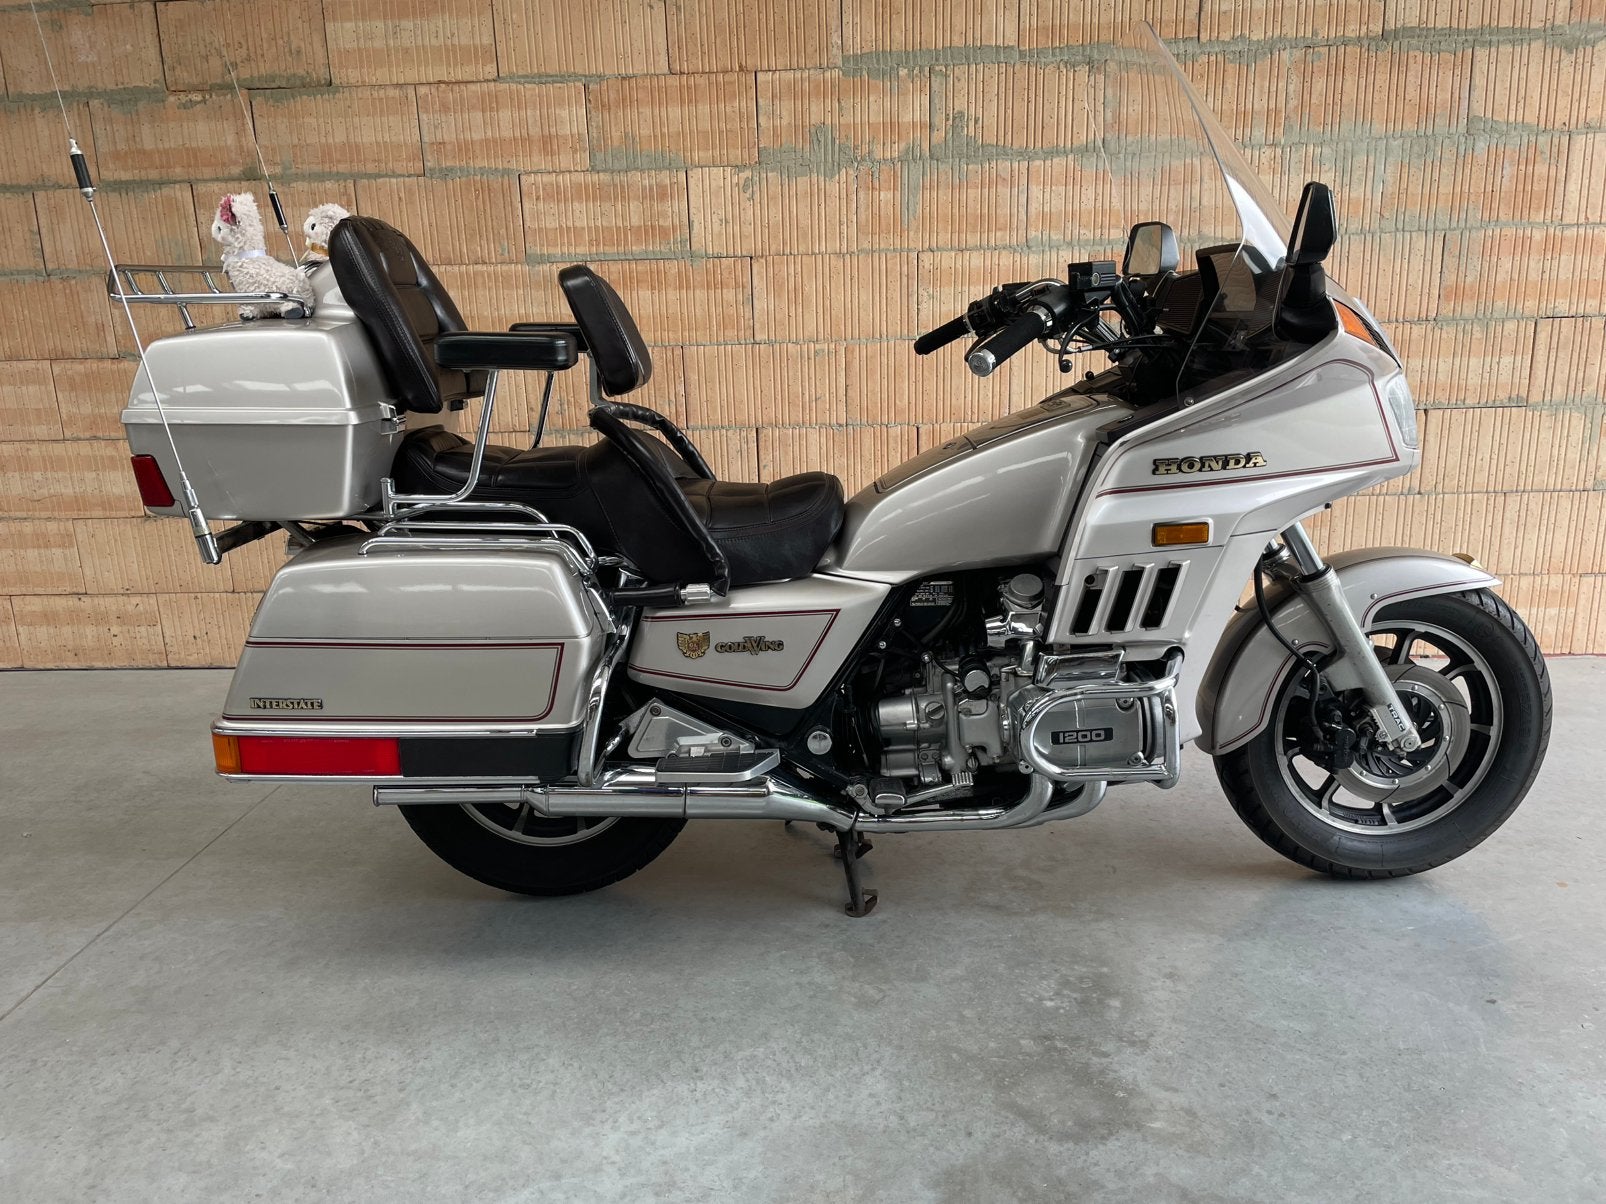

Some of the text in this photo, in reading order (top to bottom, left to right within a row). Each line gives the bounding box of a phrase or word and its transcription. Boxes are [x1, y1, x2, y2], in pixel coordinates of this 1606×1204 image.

[1152, 452, 1267, 475] HONDA
[249, 697, 323, 709] INTERSTATE
[1388, 703, 1406, 732] TRAC
[1060, 730, 1105, 743] 1200
